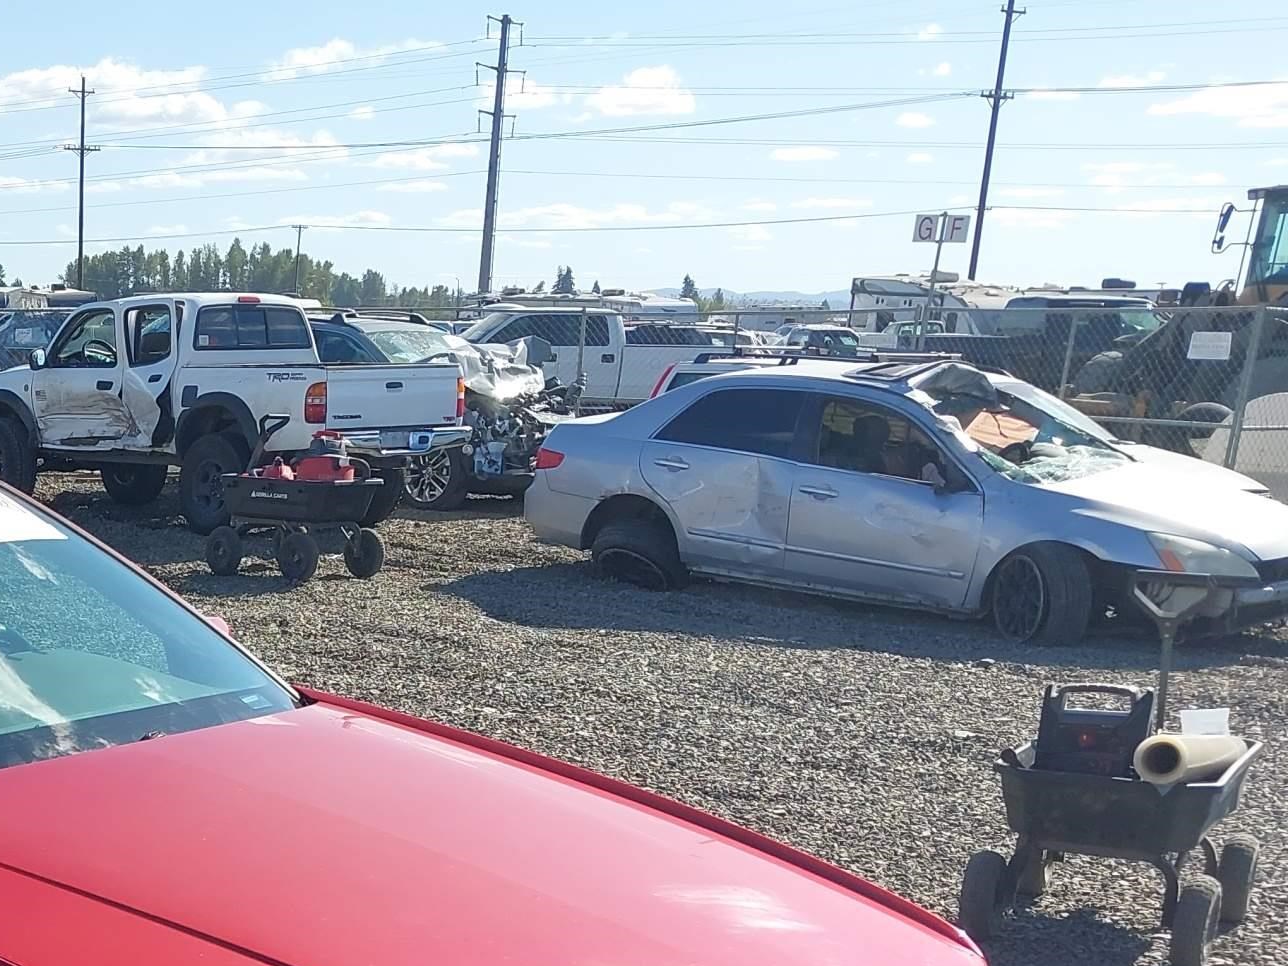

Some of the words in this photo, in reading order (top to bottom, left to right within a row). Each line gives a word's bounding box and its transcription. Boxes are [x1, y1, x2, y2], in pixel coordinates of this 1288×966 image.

[918, 216, 934, 240] G
[950, 217, 965, 240] F
[266, 372, 290, 383] TRD
